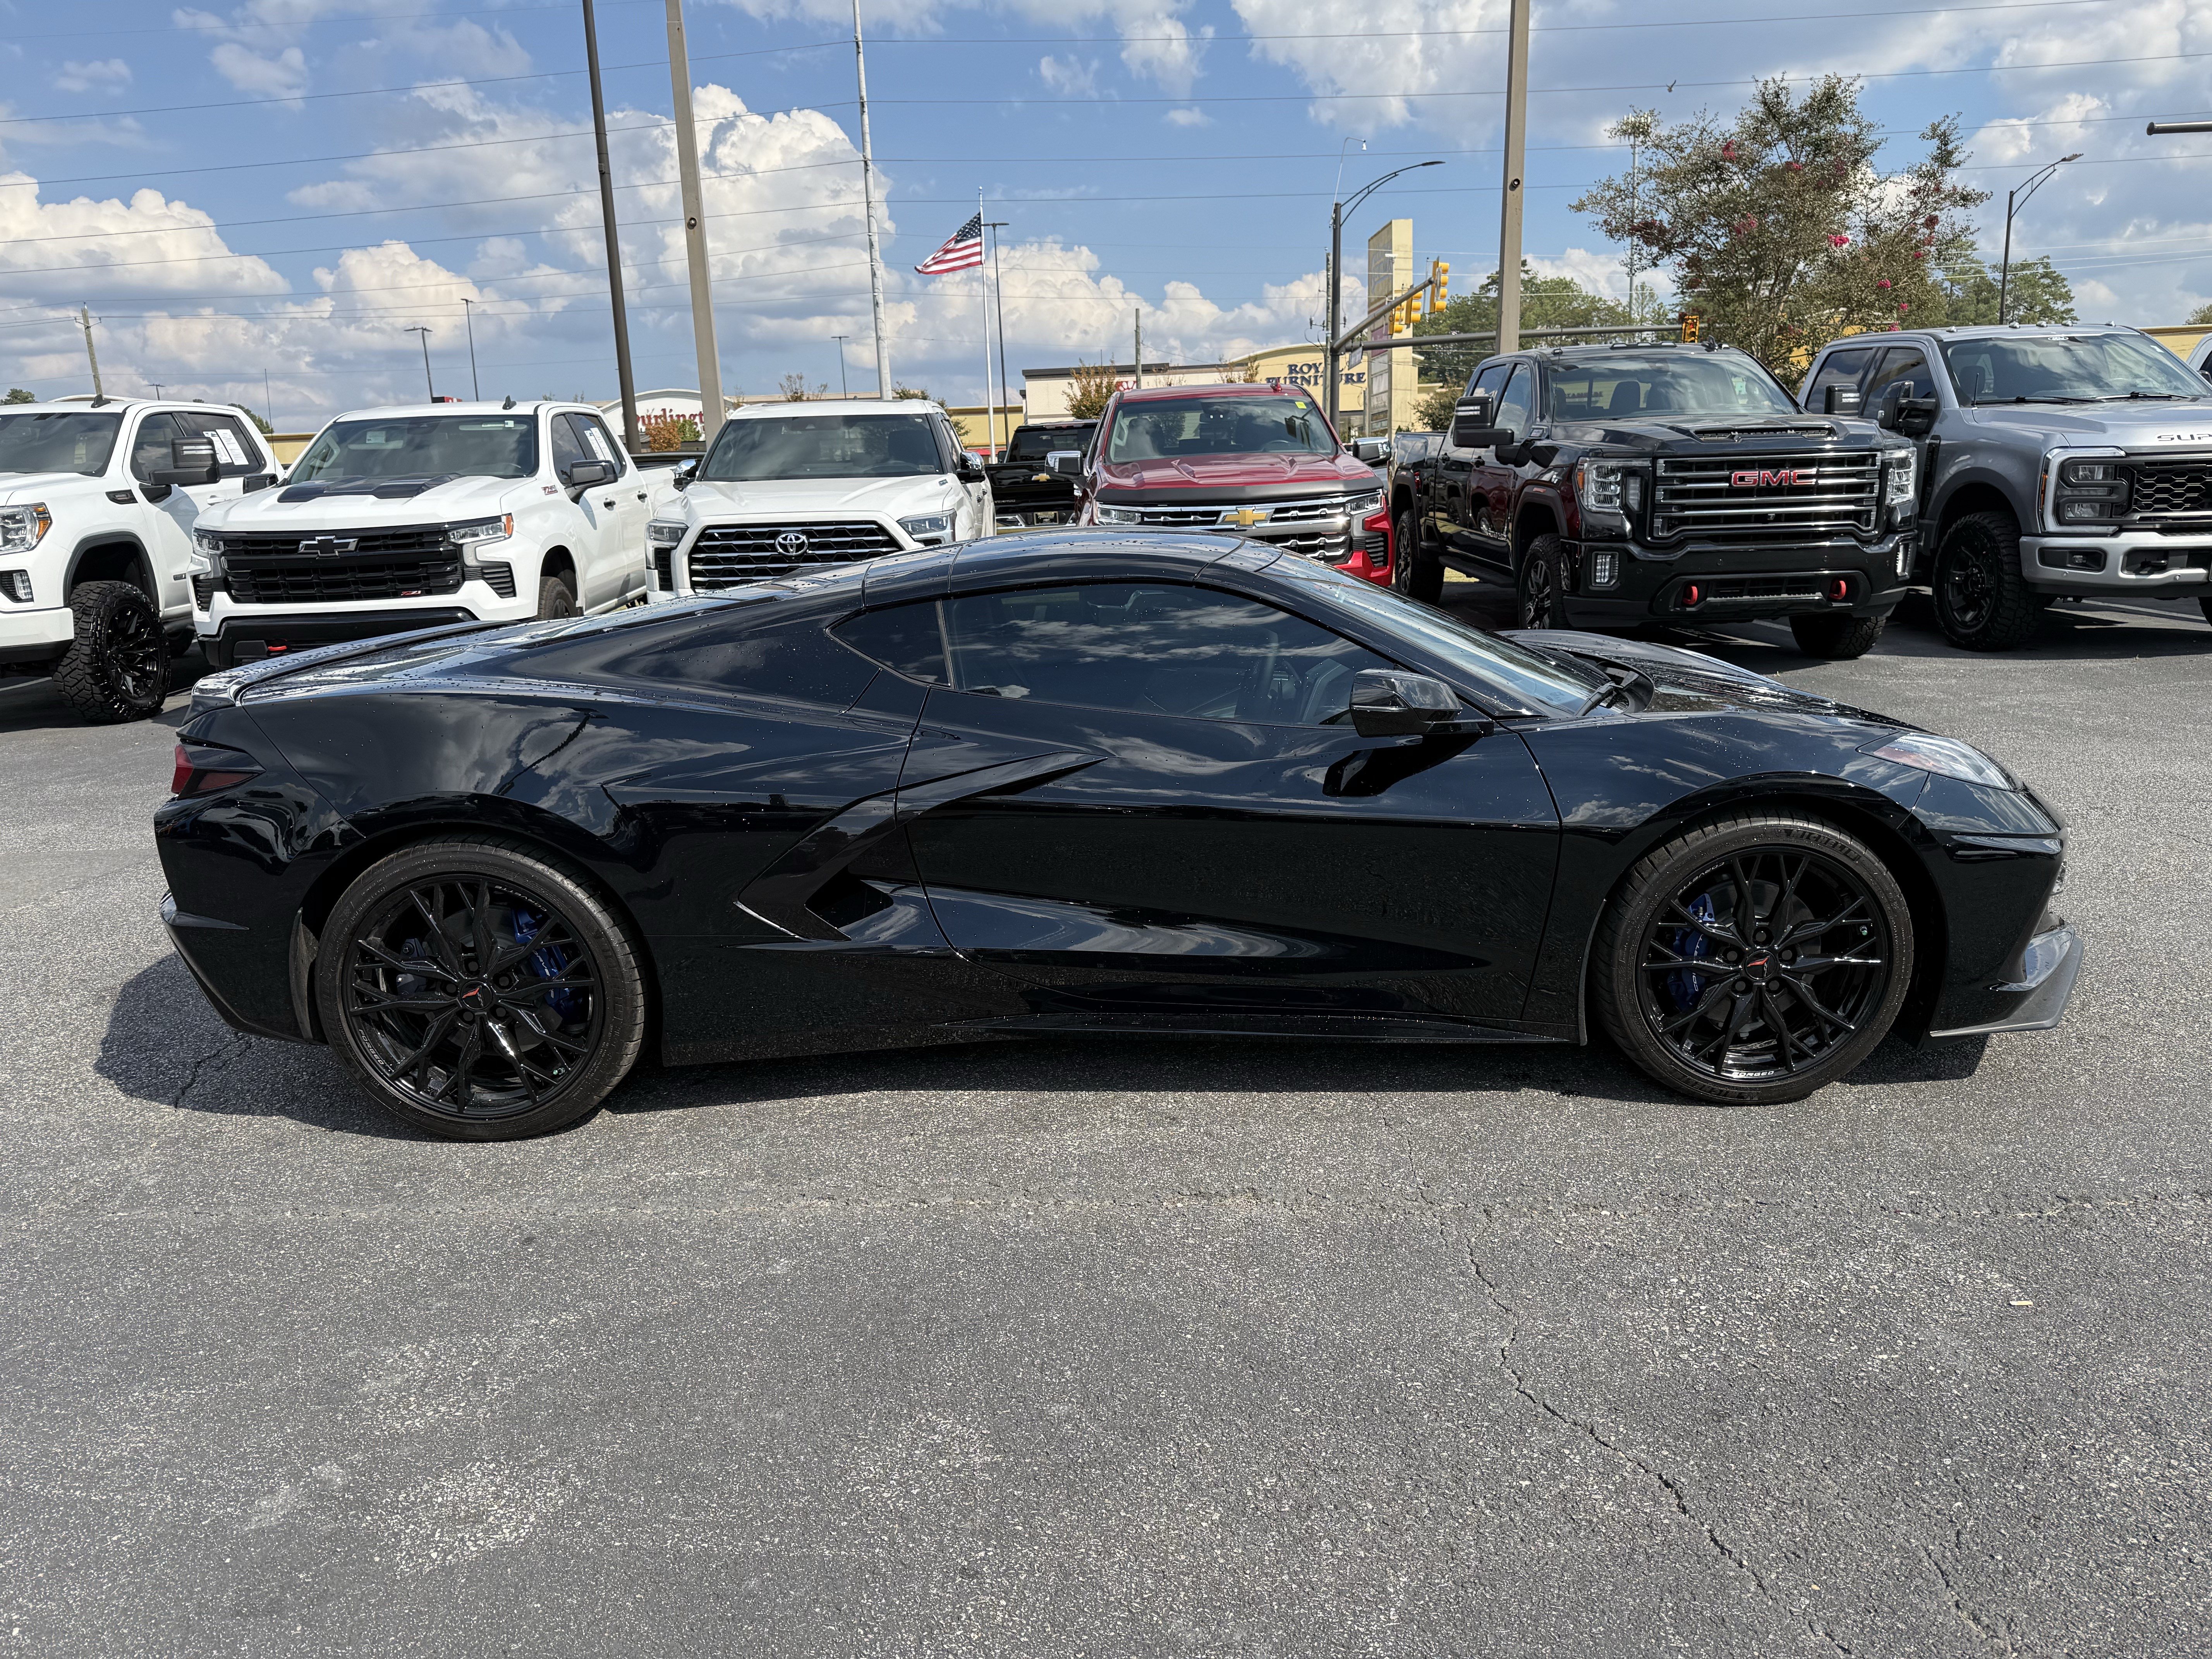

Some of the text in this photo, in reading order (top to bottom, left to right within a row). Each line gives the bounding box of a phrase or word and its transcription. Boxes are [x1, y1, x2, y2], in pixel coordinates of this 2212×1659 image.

[1266, 372, 1366, 387] FURNIRE
[1287, 362, 1343, 375] ROY
[637, 408, 705, 429] urlingt
[1732, 467, 1817, 486] GMC
[1790, 829, 1861, 861] MICHELIN
[1677, 862, 1724, 895] CORVETTE
[494, 885, 547, 911] CORVETTE
[359, 1029, 384, 1065] FORGED
